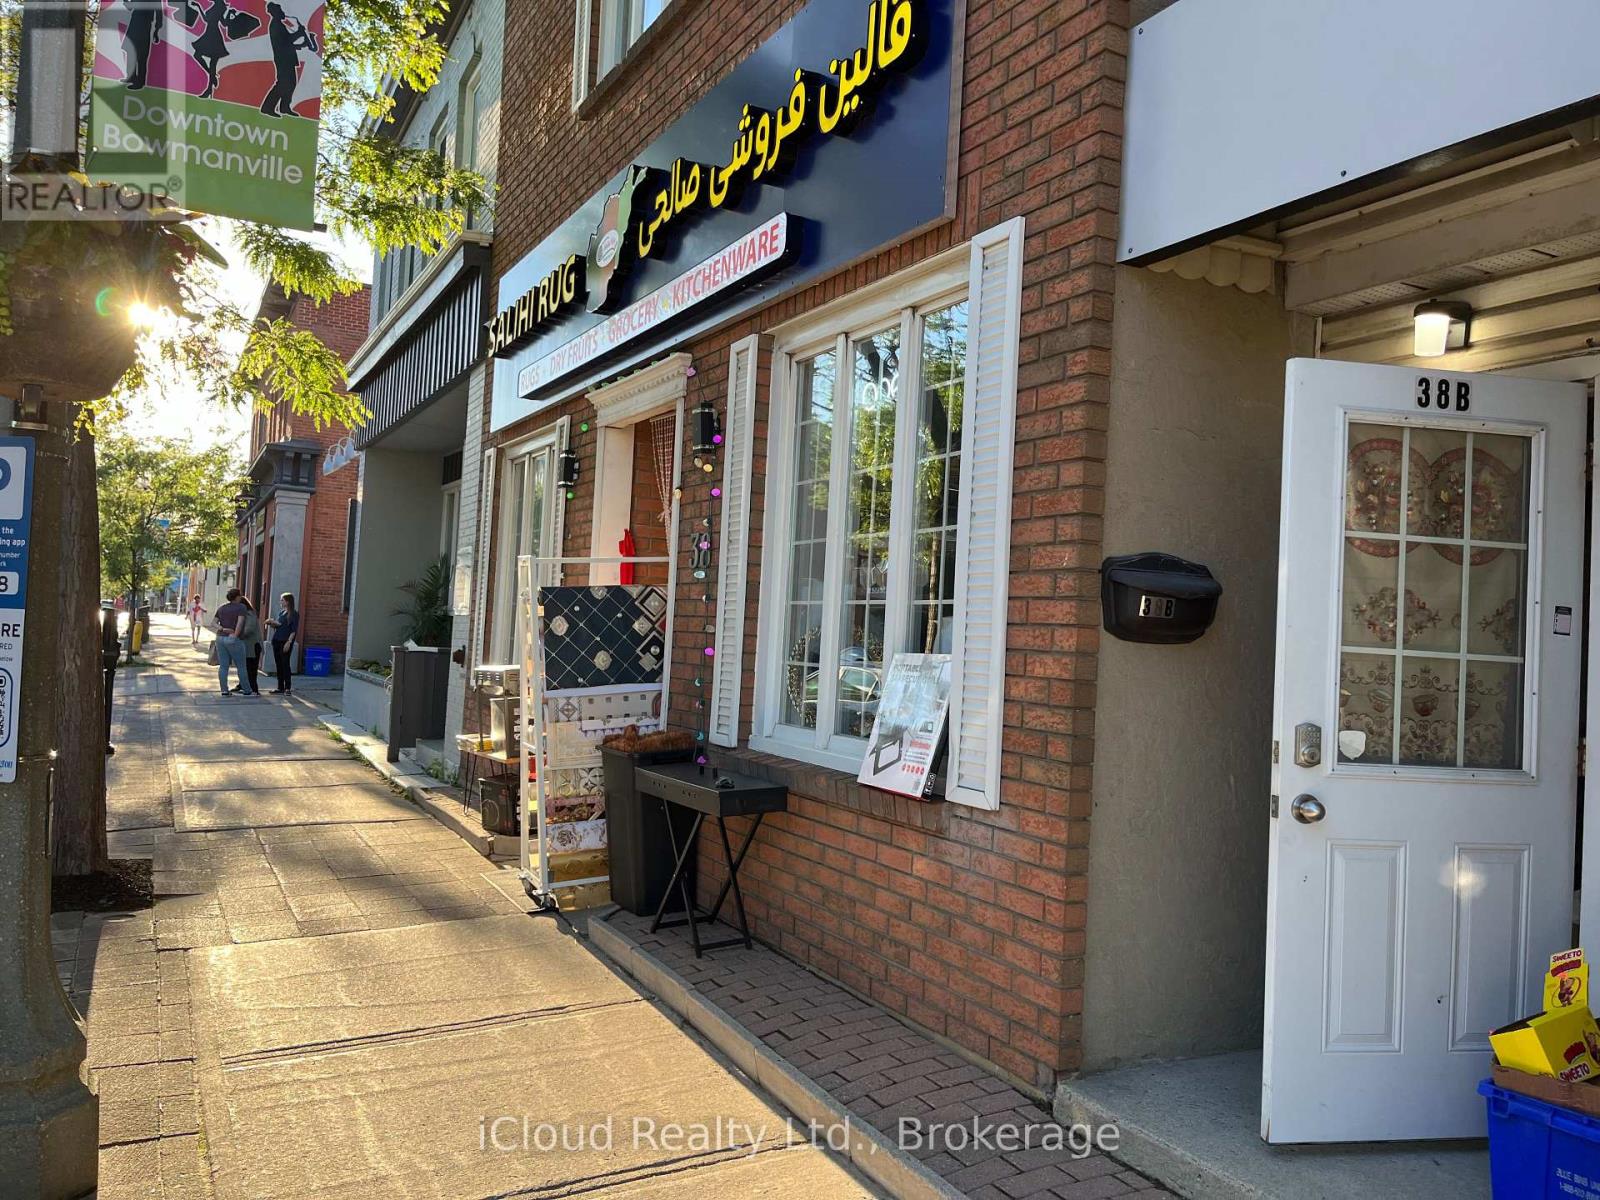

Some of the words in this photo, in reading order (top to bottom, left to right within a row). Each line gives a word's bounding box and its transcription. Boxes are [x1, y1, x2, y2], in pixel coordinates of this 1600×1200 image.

[123, 96, 289, 151] Downtown
[103, 123, 304, 185] Bowmanville
[488, 286, 535, 358] SALIHI
[538, 252, 576, 324] RUG
[608, 294, 660, 343] GROCERY
[673, 222, 780, 310] KITCHENWARE
[1417, 377, 1470, 412] 38B
[2, 526, 14, 534] the
[12, 539, 26, 547] app
[1552, 949, 1582, 962] SWEETO
